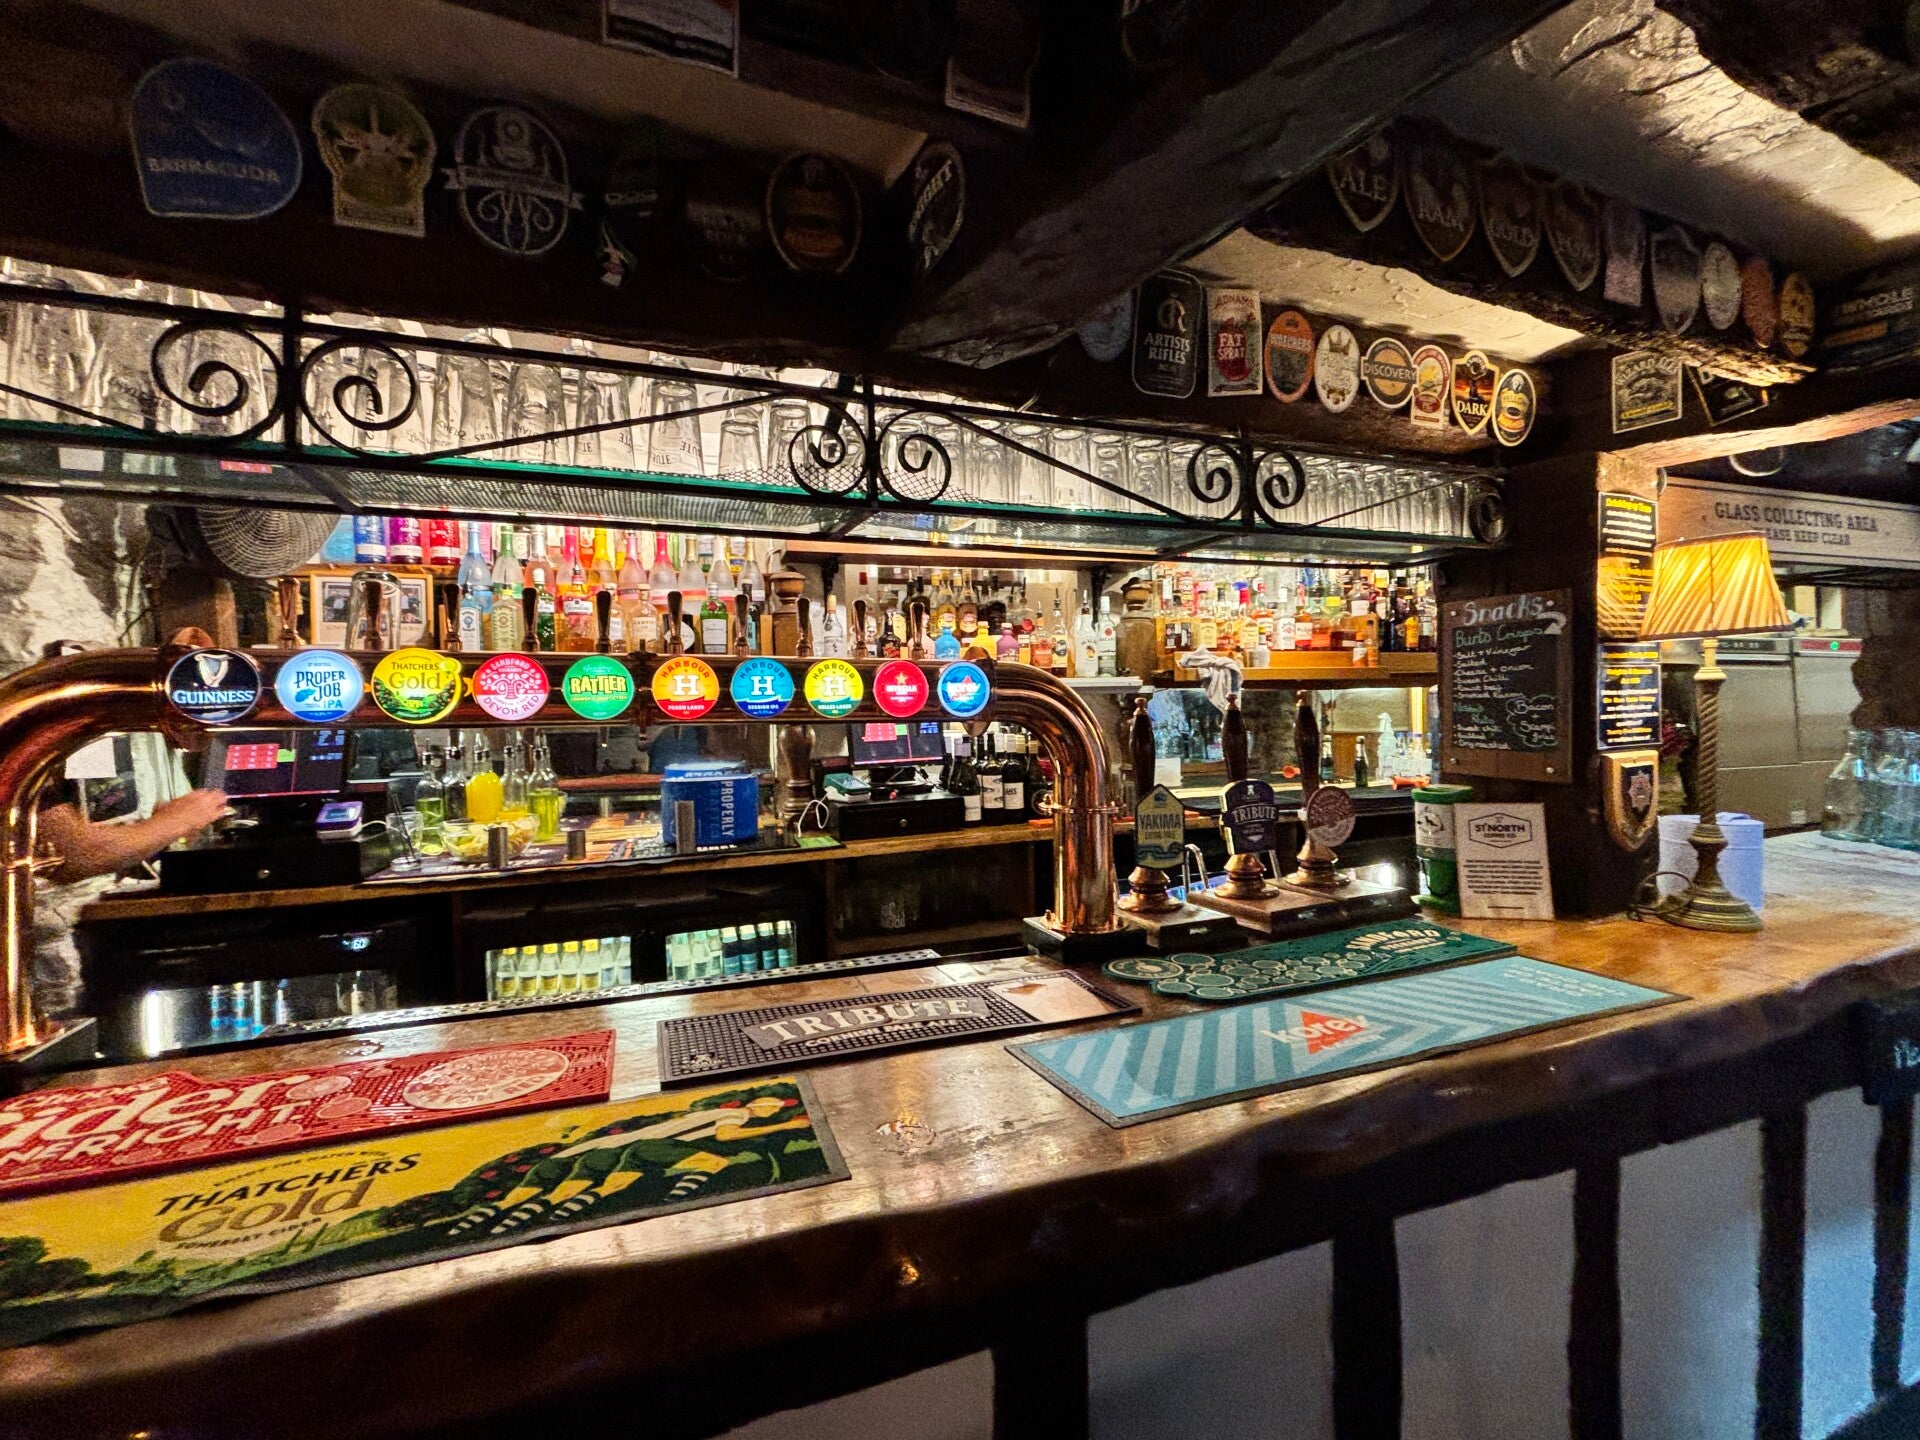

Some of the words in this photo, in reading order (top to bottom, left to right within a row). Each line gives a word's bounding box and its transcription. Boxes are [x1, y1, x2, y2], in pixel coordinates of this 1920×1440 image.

[1339, 167, 1387, 202] ALE
[1144, 333, 1191, 353] ARTISTS
[1219, 333, 1245, 347] FAT
[1148, 347, 1187, 364] RIFLES
[1363, 362, 1417, 379] DISCOVERY
[1457, 400, 1489, 415] DARK
[1715, 501, 1760, 521] GLASS
[1763, 507, 1843, 528] COLLECTING
[1847, 516, 1878, 532] AREA
[391, 661, 439, 670] THATCHERS
[490, 658, 531, 671] SANDFORD
[662, 660, 710, 678] HARBOUR
[740, 661, 785, 679] HARBOUR
[812, 662, 856, 680] HARBOUR
[295, 671, 346, 688] PROPER
[388, 671, 441, 690] Gold
[570, 674, 628, 695] RATTLER
[673, 674, 699, 696] H
[751, 675, 775, 696] H
[822, 676, 847, 696] H
[172, 689, 255, 704] GUINNESS
[313, 682, 341, 701] JOB
[323, 699, 343, 709] IPA
[483, 696, 519, 716] DEVON
[520, 694, 540, 713] RED
[721, 780, 735, 836] PROPERLY
[1231, 806, 1277, 823] TRIBUTE
[1138, 813, 1183, 829] YAKIMA
[758, 997, 974, 1043] TRIBUTE
[1259, 1014, 1370, 1045] korev
[805, 1026, 881, 1048] CORNISH
[884, 1020, 926, 1033] PALE
[927, 1018, 958, 1027] ALE
[0, 1075, 311, 1150] ider
[154, 1152, 423, 1217] THATCHERS
[159, 1178, 375, 1243] Gold
